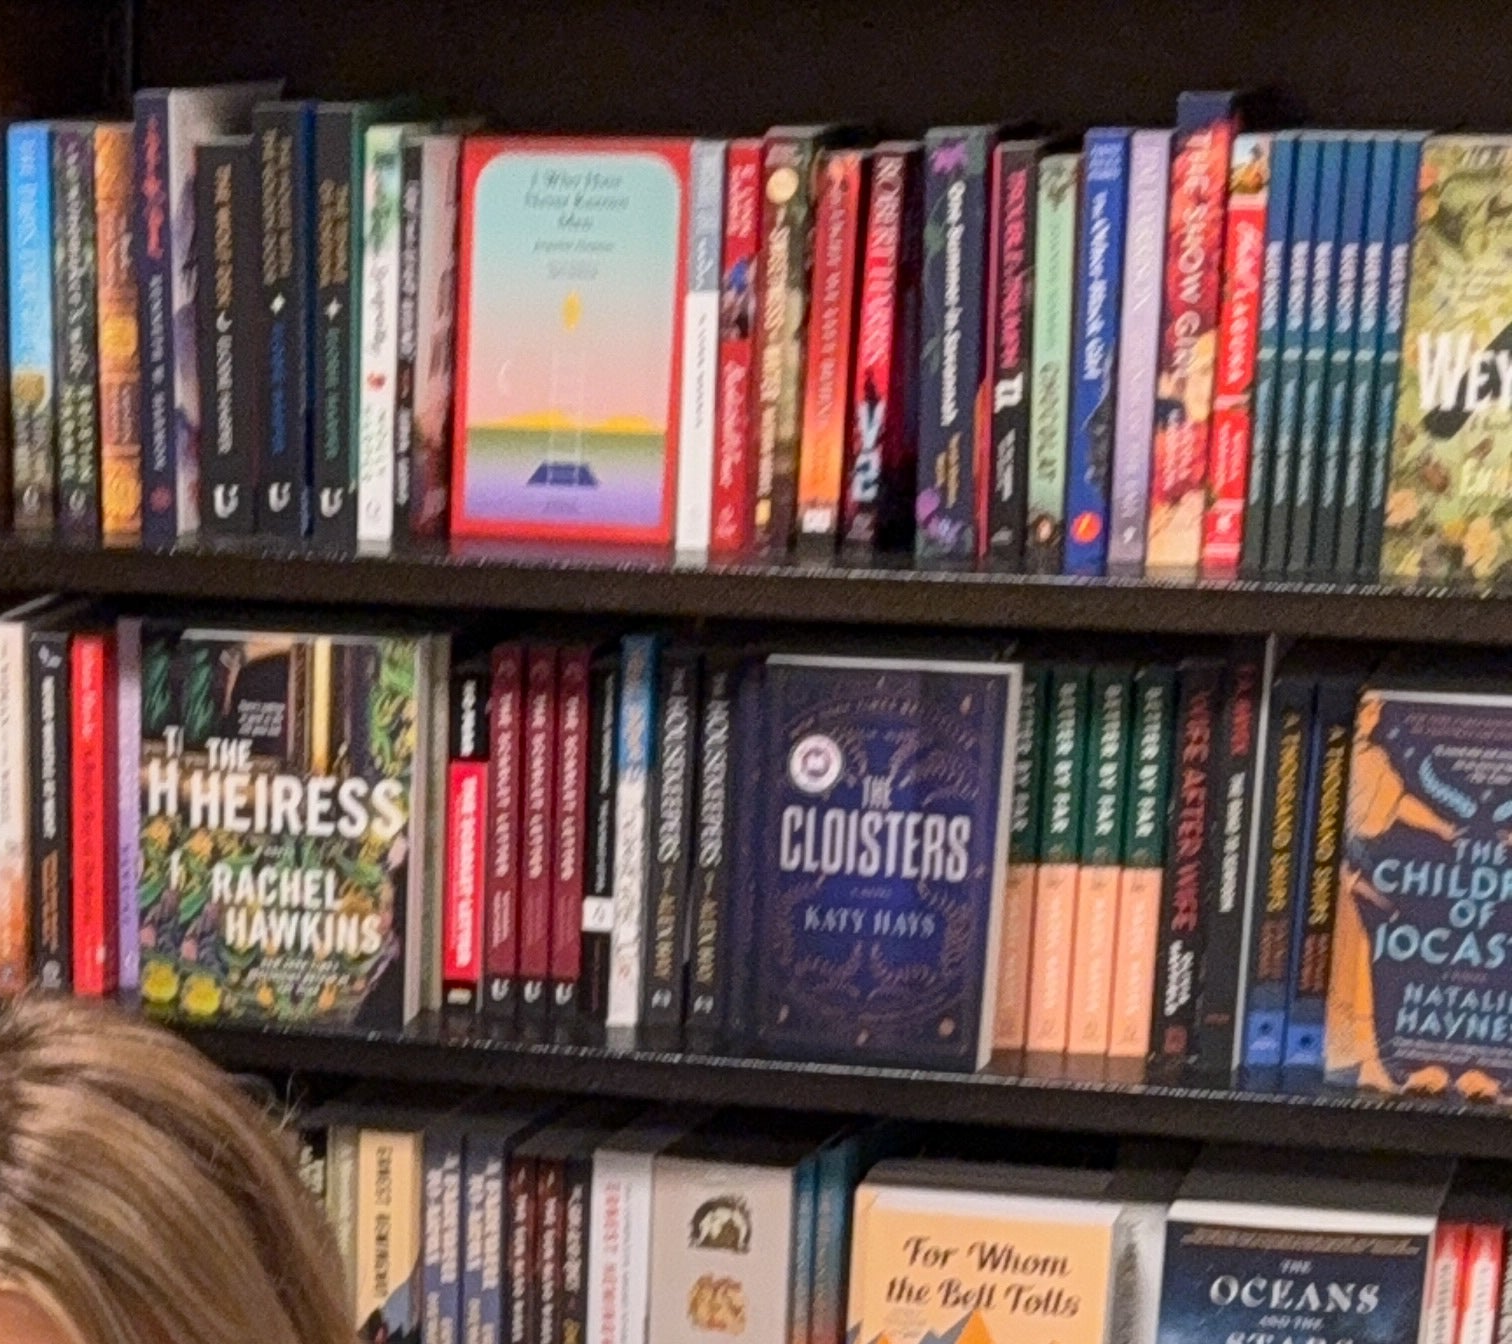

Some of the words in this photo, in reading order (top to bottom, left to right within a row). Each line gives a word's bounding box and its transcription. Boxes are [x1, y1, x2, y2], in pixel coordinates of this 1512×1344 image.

[207, 737, 252, 773] THE
[190, 770, 408, 838] HEIRESS
[861, 776, 891, 809] THE
[780, 805, 971, 883] CLOISTERS
[1454, 838, 1507, 866] THE
[212, 862, 340, 912] RACHEL
[226, 907, 383, 958] HAWKINS
[803, 905, 863, 934] KATY
[873, 908, 935, 939] HAYS
[1449, 899, 1494, 930] OF
[903, 1237, 956, 1271] For
[966, 1239, 1071, 1277] Whom
[888, 1275, 930, 1303] the
[937, 1275, 996, 1310] Bell
[1003, 1283, 1082, 1319] Tolls
[1209, 1273, 1381, 1315] OCEANS
